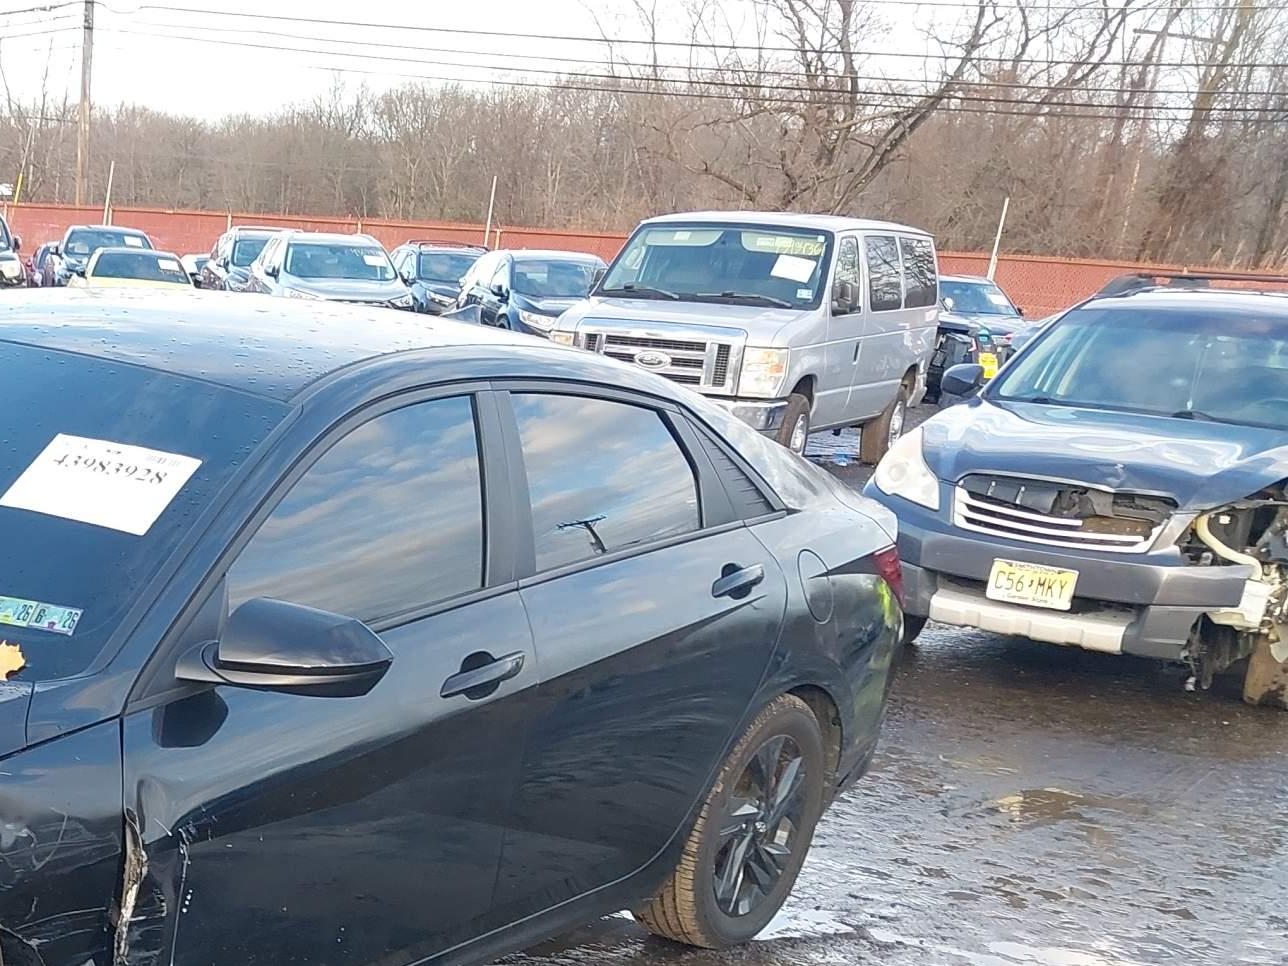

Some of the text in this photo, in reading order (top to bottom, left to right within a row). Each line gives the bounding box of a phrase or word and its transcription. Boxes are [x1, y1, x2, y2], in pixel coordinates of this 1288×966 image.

[52, 453, 168, 485] 43983928
[16, 603, 34, 622] 26
[34, 608, 79, 630] 6 26
